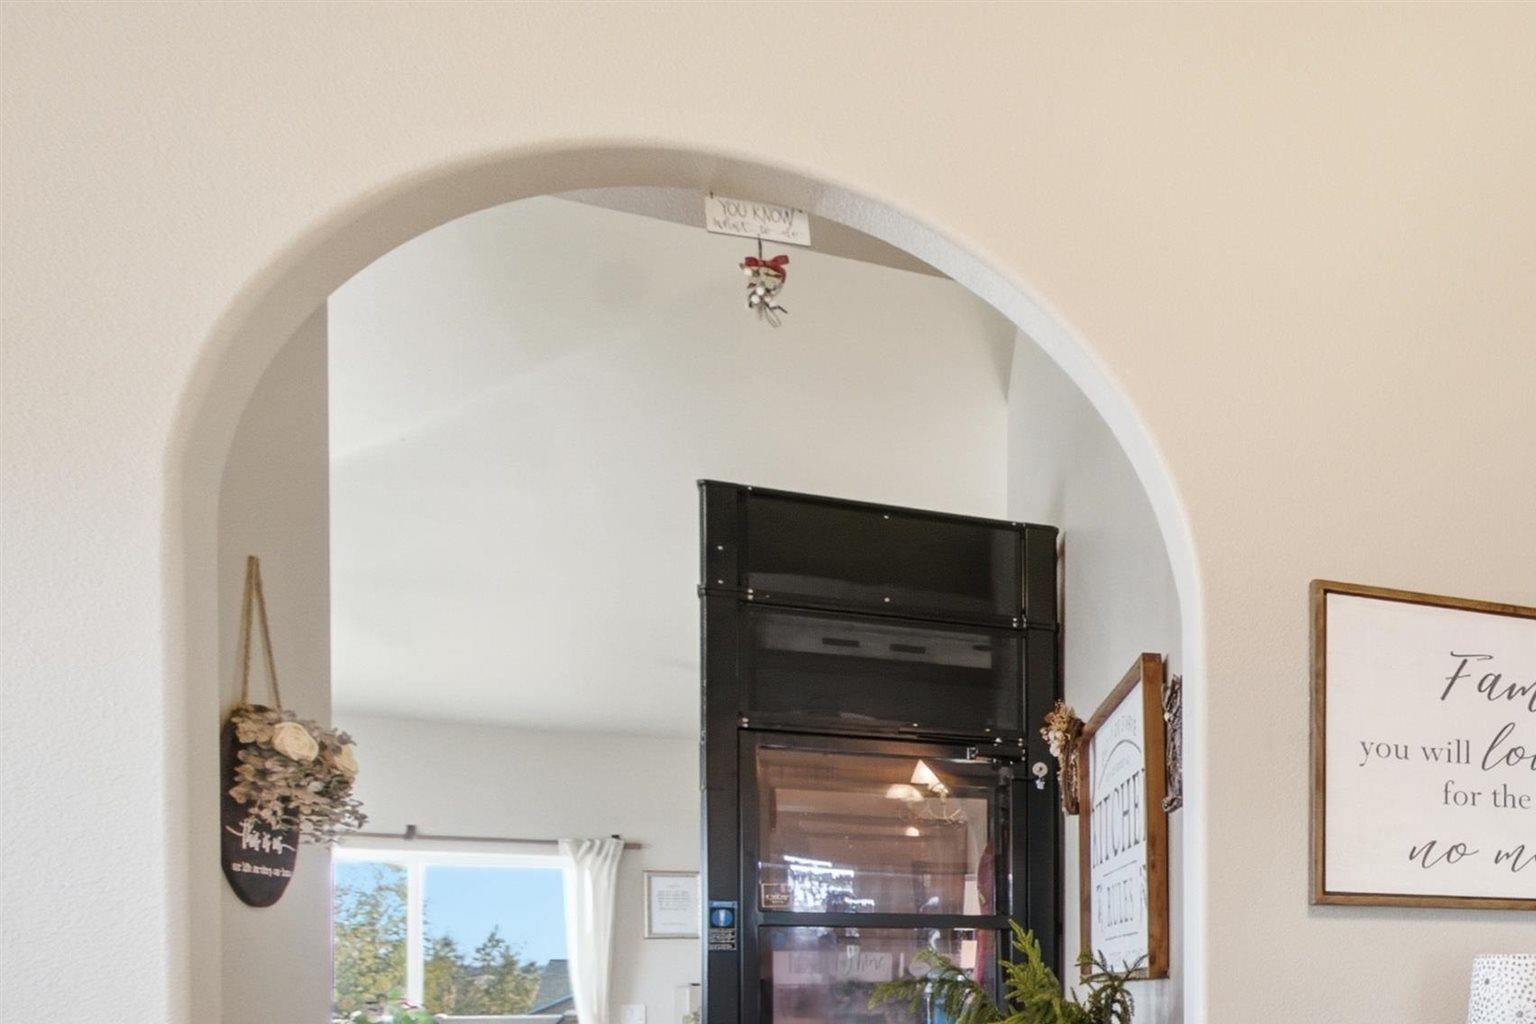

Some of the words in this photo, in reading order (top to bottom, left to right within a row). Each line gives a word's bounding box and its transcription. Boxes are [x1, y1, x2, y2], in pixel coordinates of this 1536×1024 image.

[718, 199, 748, 218] YOU
[1359, 738, 1410, 767] you
[1421, 738, 1471, 766] will
[1442, 780, 1483, 808] for
[1491, 784, 1532, 810] the
[1091, 767, 1147, 869] KITCHE
[1408, 839, 1480, 867] no
